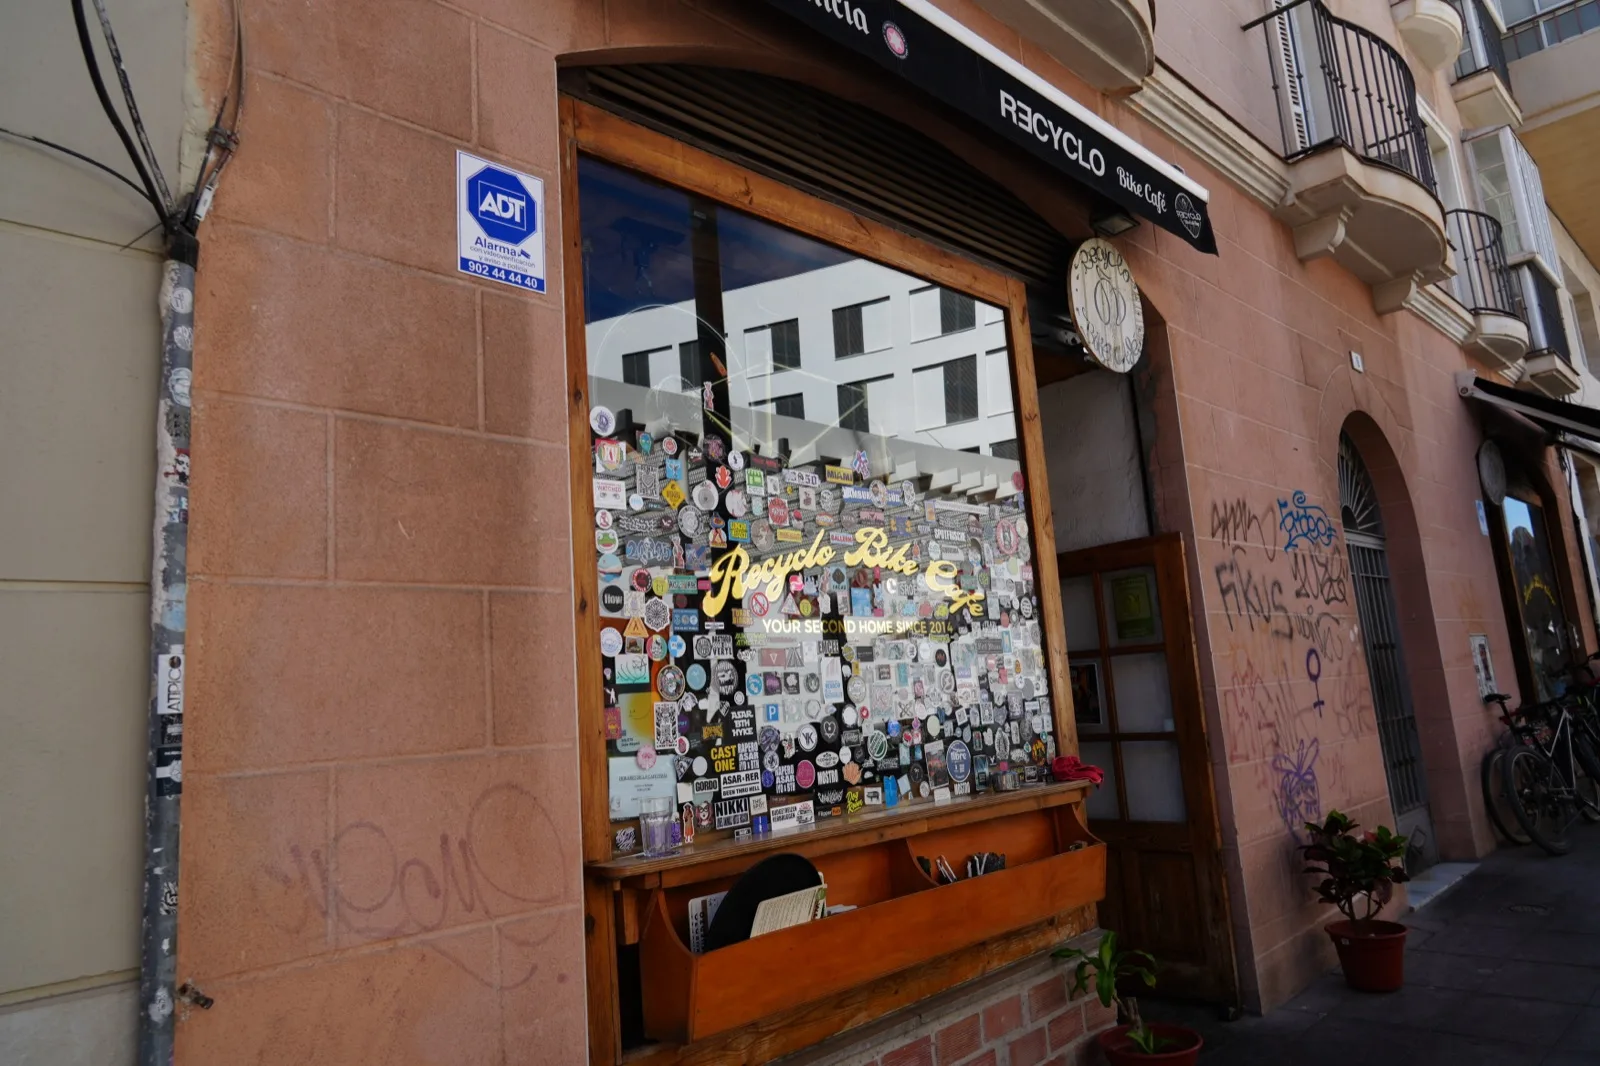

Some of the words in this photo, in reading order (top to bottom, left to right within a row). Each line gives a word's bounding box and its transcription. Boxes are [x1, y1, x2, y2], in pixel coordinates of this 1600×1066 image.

[1000, 89, 1106, 177] RECYCLO
[1116, 166, 1144, 198] Bike
[1144, 183, 1168, 214] Café
[480, 190, 525, 223] ADT
[474, 236, 517, 257] Alarma
[468, 260, 489, 276] 902
[492, 268, 506, 281] 44
[509, 272, 523, 285] 44
[525, 277, 538, 289] 40
[702, 529, 836, 617] Recyclo
[844, 527, 919, 575] Bike
[925, 560, 984, 617] Café
[763, 619, 801, 634] YOUR
[804, 619, 856, 634] SECOND
[859, 619, 894, 634] HOME
[896, 619, 927, 634] SINCE
[930, 619, 953, 634] 2014
[710, 745, 737, 760] CAST
[714, 758, 735, 773] ONE
[695, 780, 718, 793] GORDO
[723, 774, 742, 786] ASAR
[746, 772, 759, 783] RER
[723, 788, 736, 797] BEEN
[715, 797, 748, 817] NIKKI
